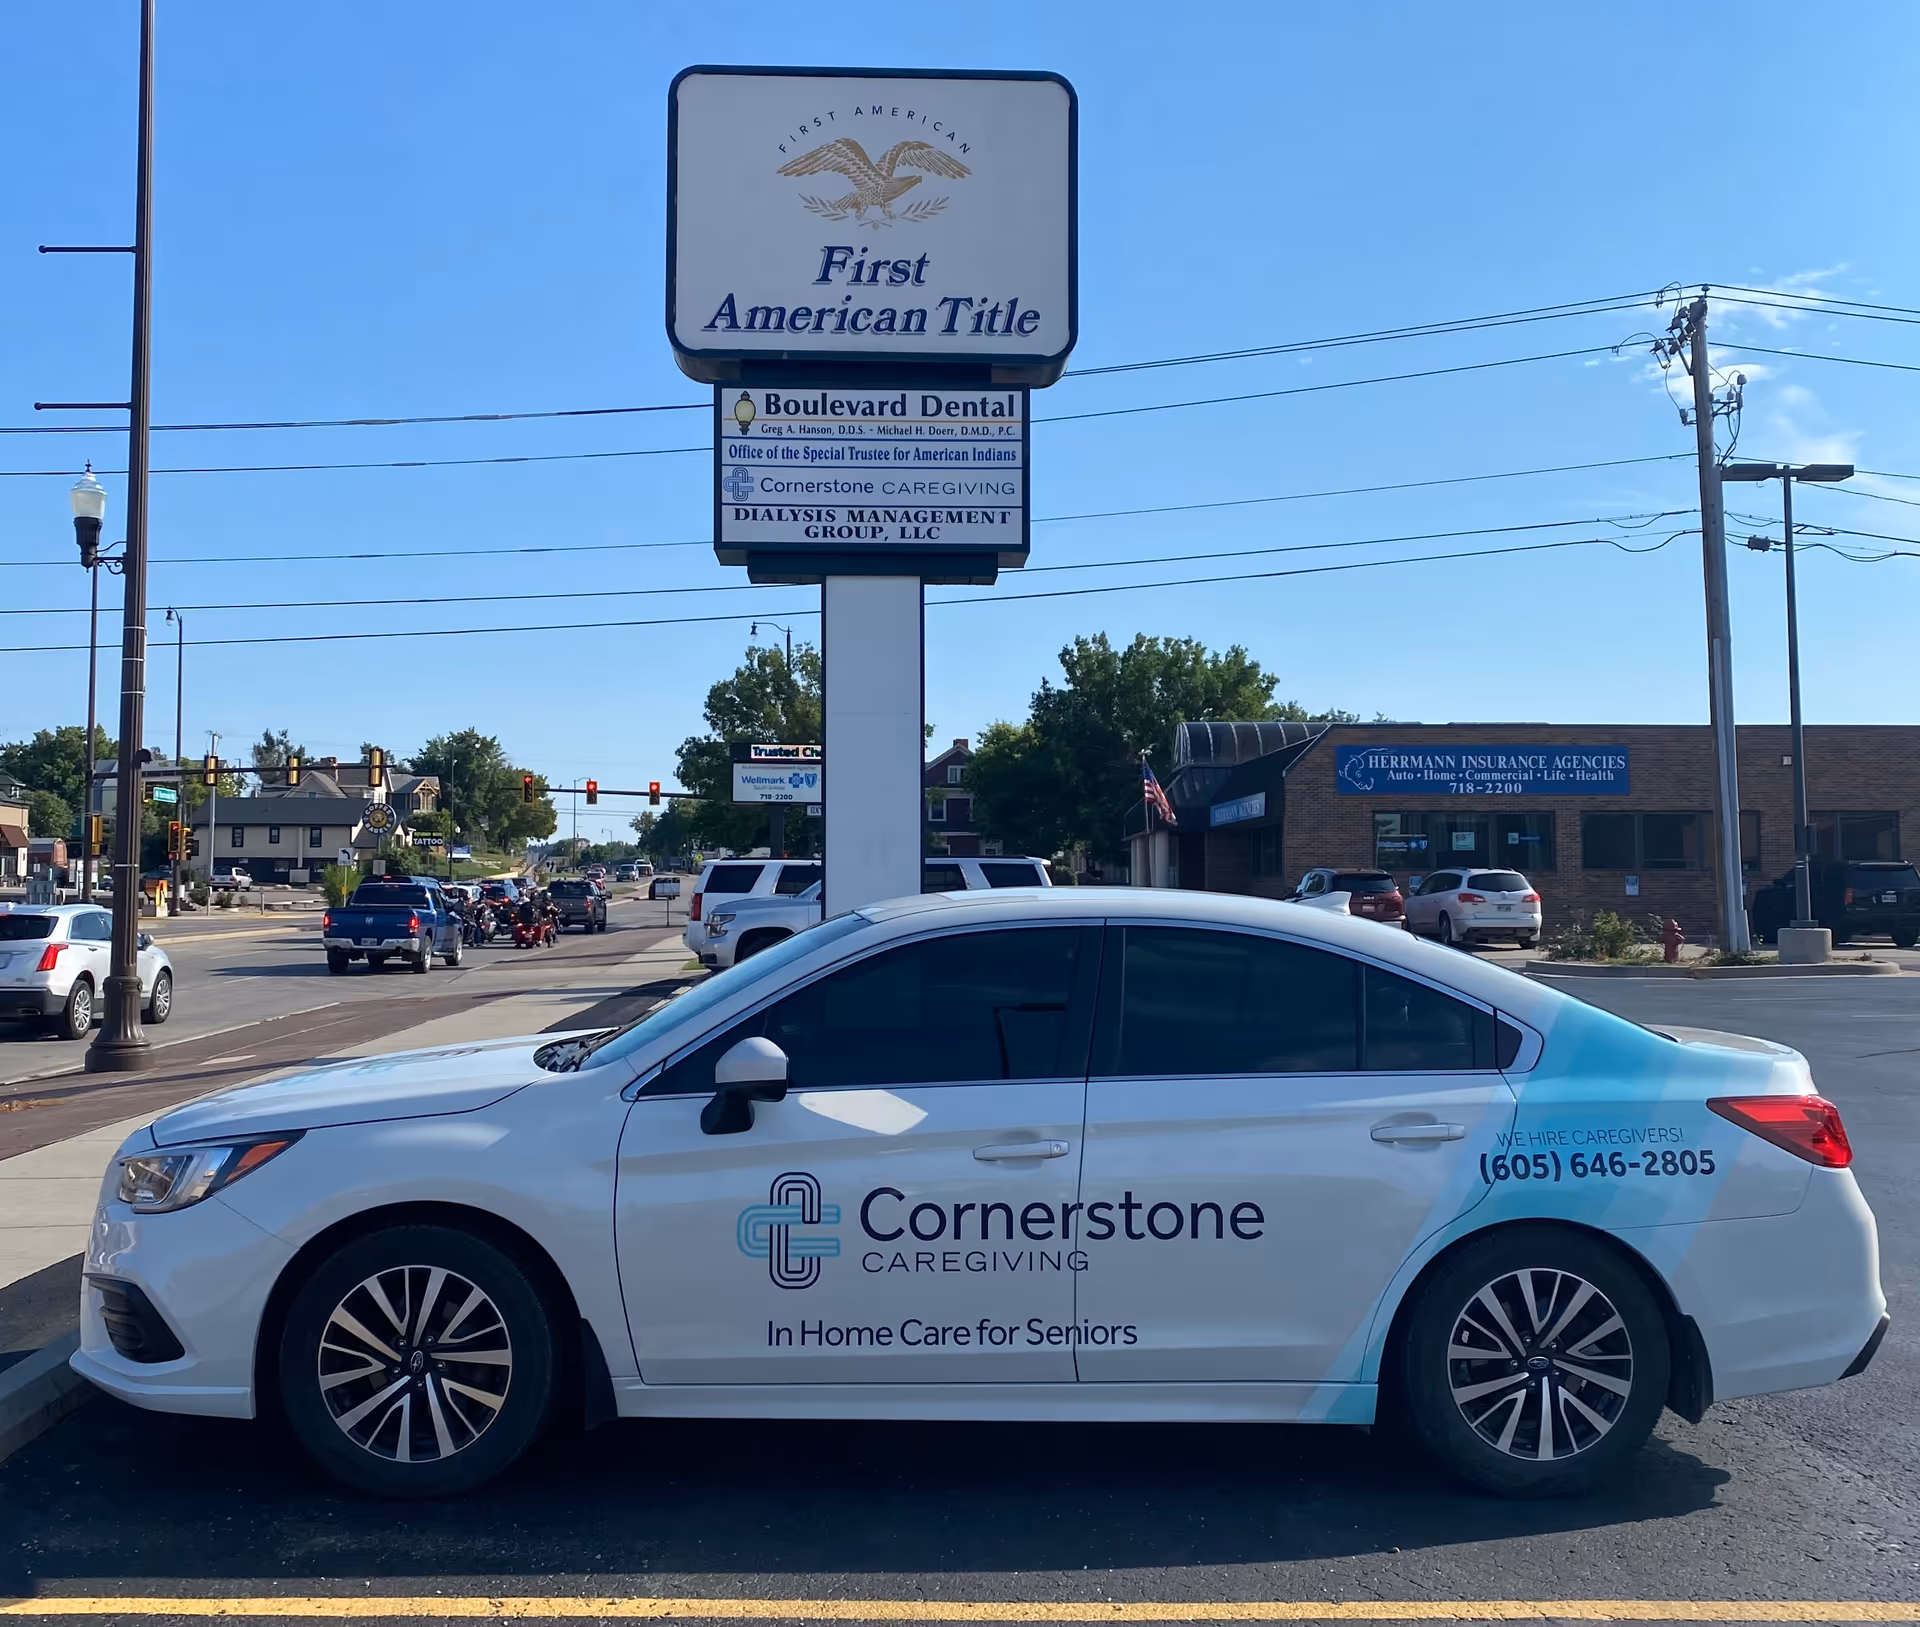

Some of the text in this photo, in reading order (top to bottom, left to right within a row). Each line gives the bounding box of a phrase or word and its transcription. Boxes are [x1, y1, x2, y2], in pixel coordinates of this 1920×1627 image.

[778, 105, 971, 155] FIRST AMERICAN
[812, 245, 930, 286] First
[700, 293, 1041, 337] American Title
[765, 393, 1015, 418] Boulevard Dental
[761, 424, 783, 437] Greg
[786, 424, 796, 434] A.
[799, 424, 835, 436] Hanson,
[838, 425, 866, 435] D.D.S.
[877, 425, 912, 436] Michael
[915, 426, 925, 436] H.
[928, 426, 958, 437] Doerr,
[961, 426, 995, 438] D.M.D.,
[998, 427, 1016, 437] P.C.
[728, 444, 1017, 463] Office of the Special Trustee for American Indians
[760, 477, 1016, 495] Cornerstone CAREGIVING
[733, 508, 1011, 524] DIALYSIS MANAGEMENT
[804, 526, 941, 542] GROUP, LLC
[753, 746, 800, 757] Trusted
[1368, 755, 1626, 769] HERRMANN INSURANCE AGENCIES
[741, 776, 785, 785] Wellmark
[1387, 770, 1614, 781] Auto Home Commercial Life Health
[1449, 783, 1522, 794] 718-2200
[365, 804, 392, 815] COFFEE
[365, 823, 392, 834] BAGELS
[1496, 1127, 1684, 1147] WE HIRE CAREGIVERS!
[1480, 1149, 1716, 1185] (605) 646-2805
[859, 1187, 1265, 1241] Cornerstone
[862, 1249, 1090, 1273] CAREGIVING
[767, 1318, 1137, 1347] In Home Care for Seniors
